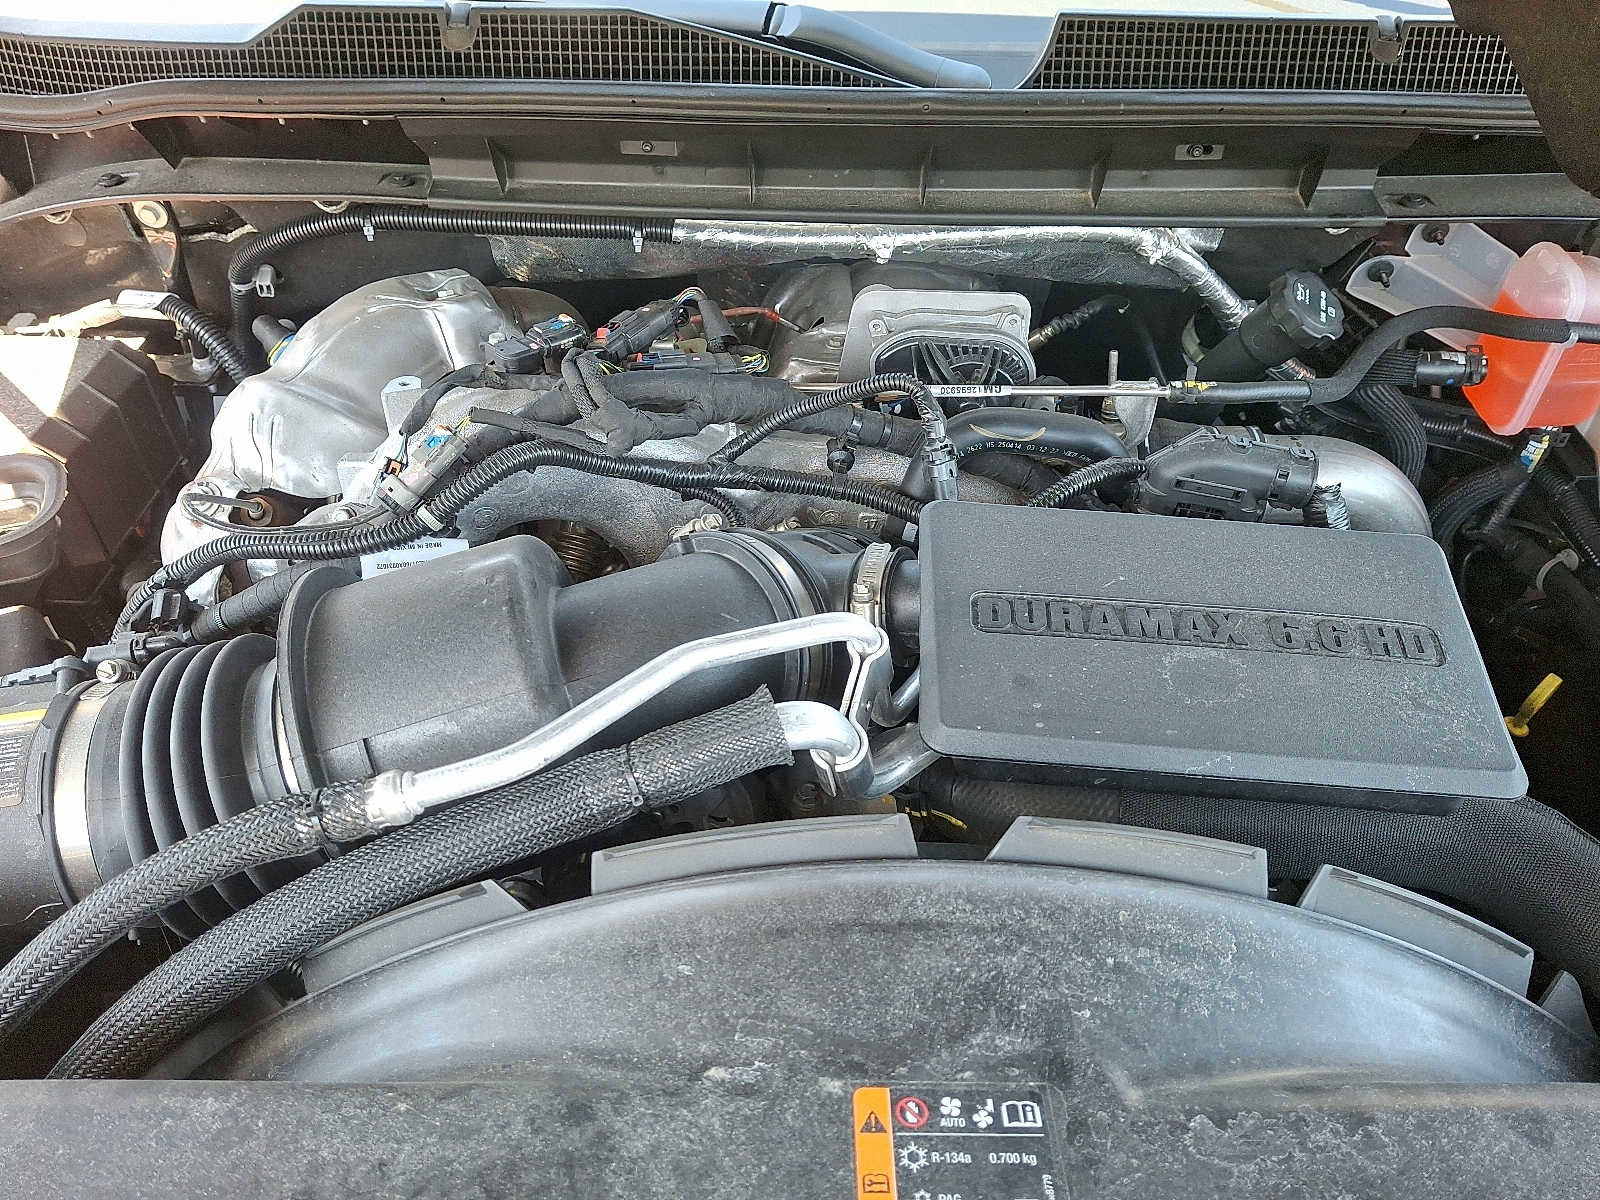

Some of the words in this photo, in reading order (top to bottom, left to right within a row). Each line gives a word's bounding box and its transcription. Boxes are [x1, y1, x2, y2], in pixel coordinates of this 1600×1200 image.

[424, 541, 442, 549] MADE
[978, 596, 1249, 646] DURAMAX
[1267, 615, 1351, 654] 6.6
[1360, 622, 1437, 662] HD
[939, 1117, 966, 1128] AUTO
[931, 1151, 973, 1164] R-134a
[989, 1152, 1020, 1164] 0.700
[1022, 1152, 1038, 1167] kg
